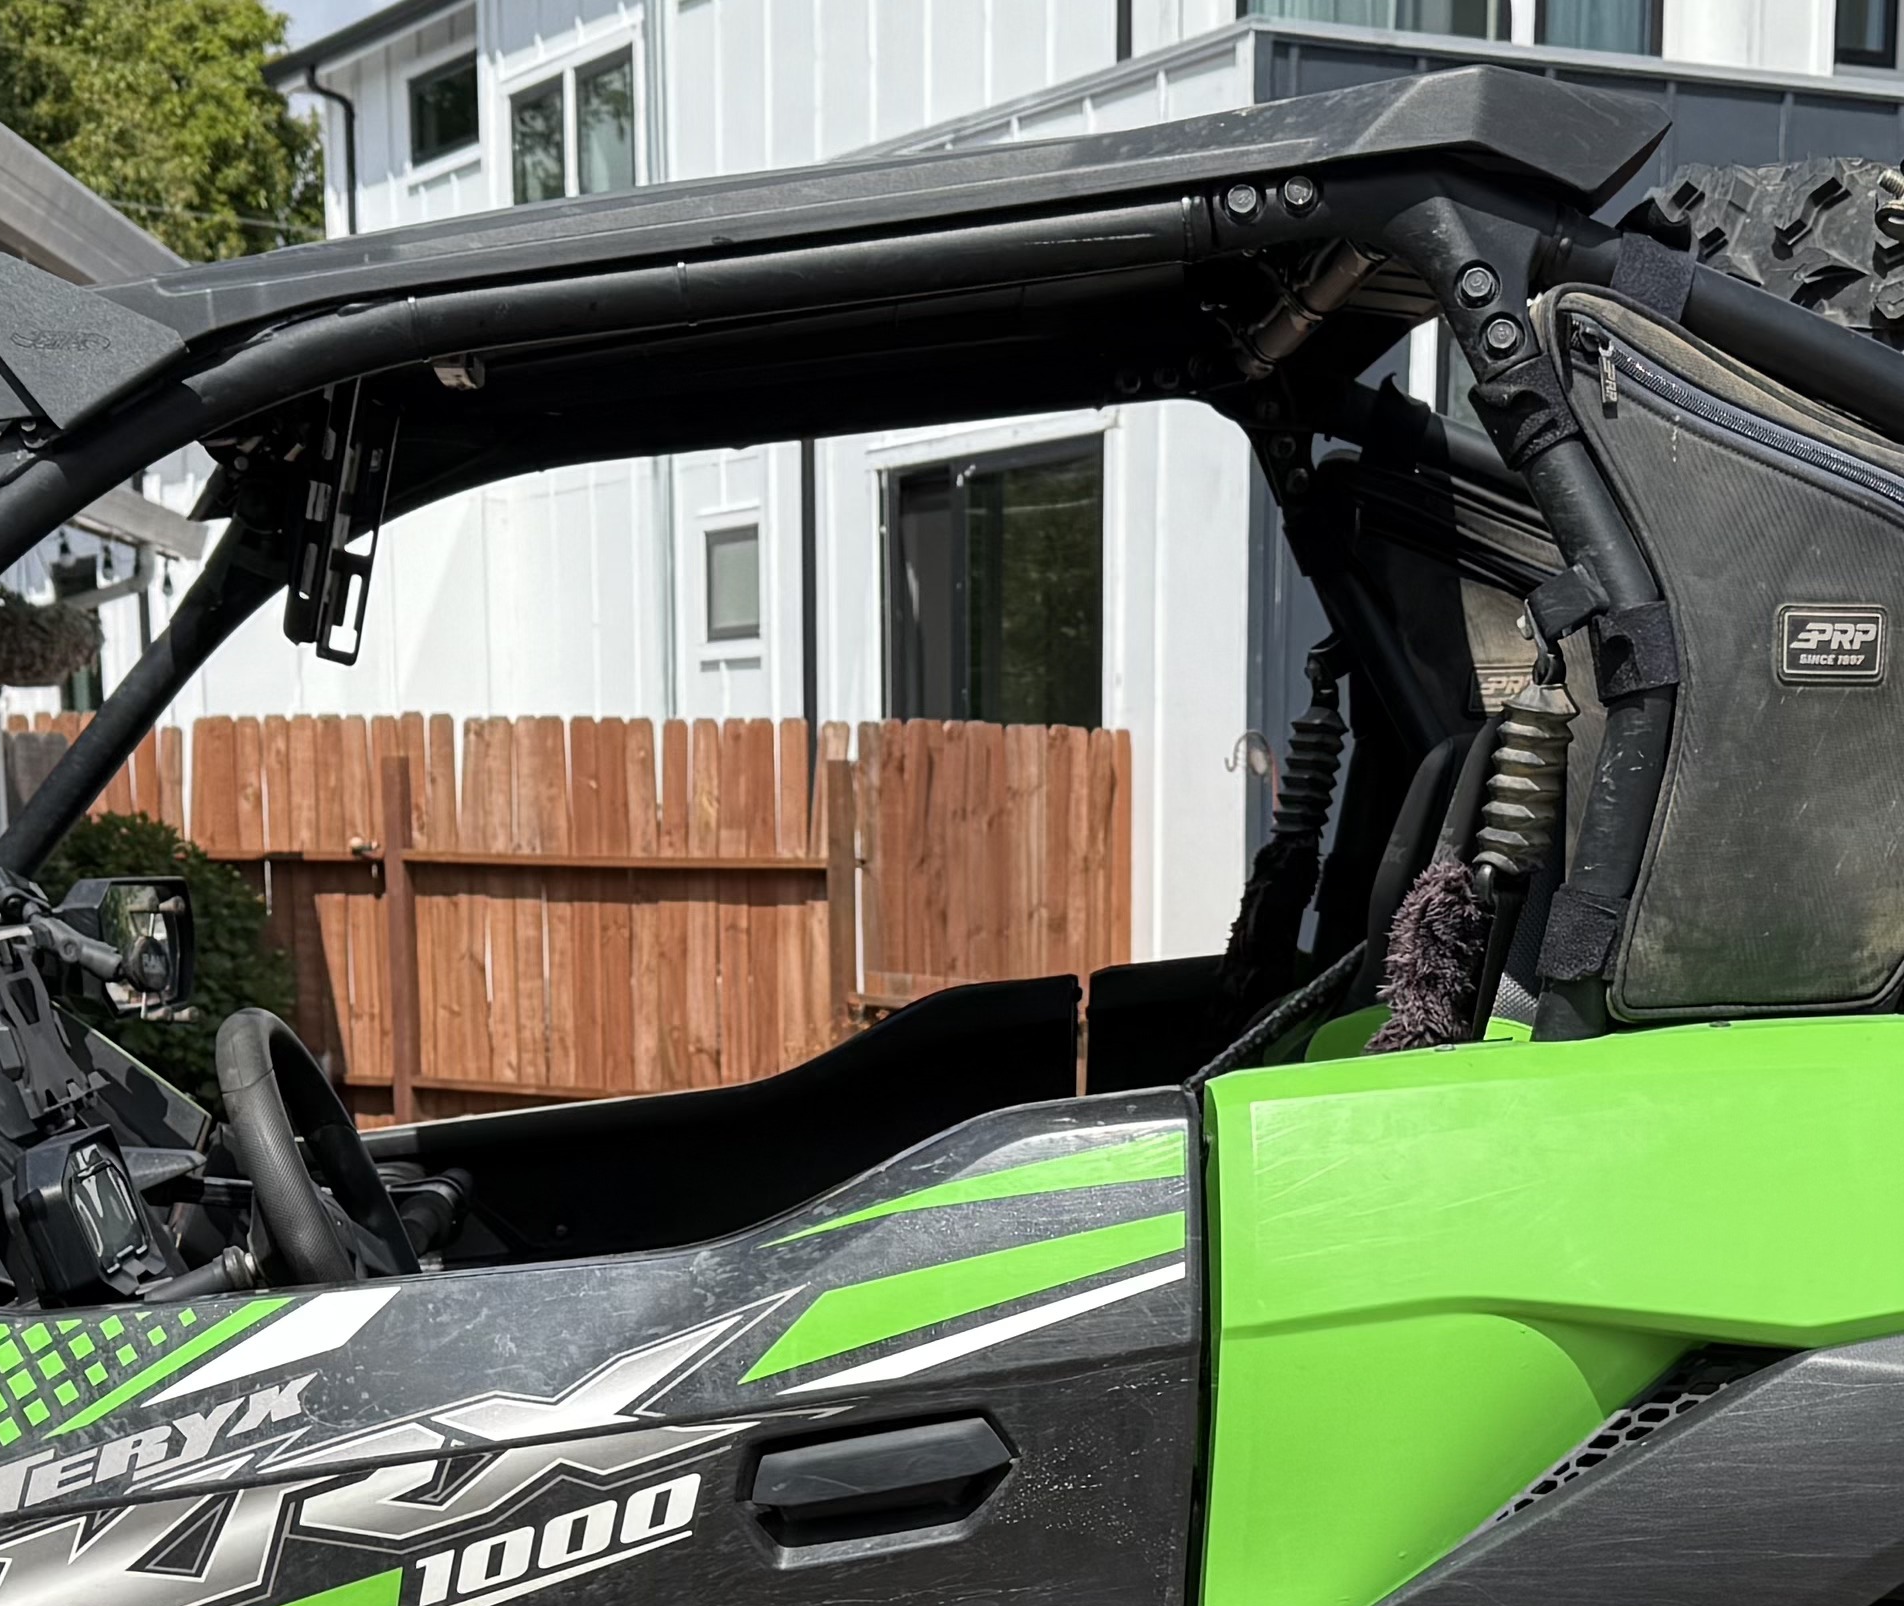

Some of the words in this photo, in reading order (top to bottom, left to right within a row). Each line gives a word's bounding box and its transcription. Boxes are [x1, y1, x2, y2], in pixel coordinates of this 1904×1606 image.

[1789, 622, 1878, 650] PRP
[1799, 654, 1836, 666] SINCE
[1480, 675, 1532, 695] PR
